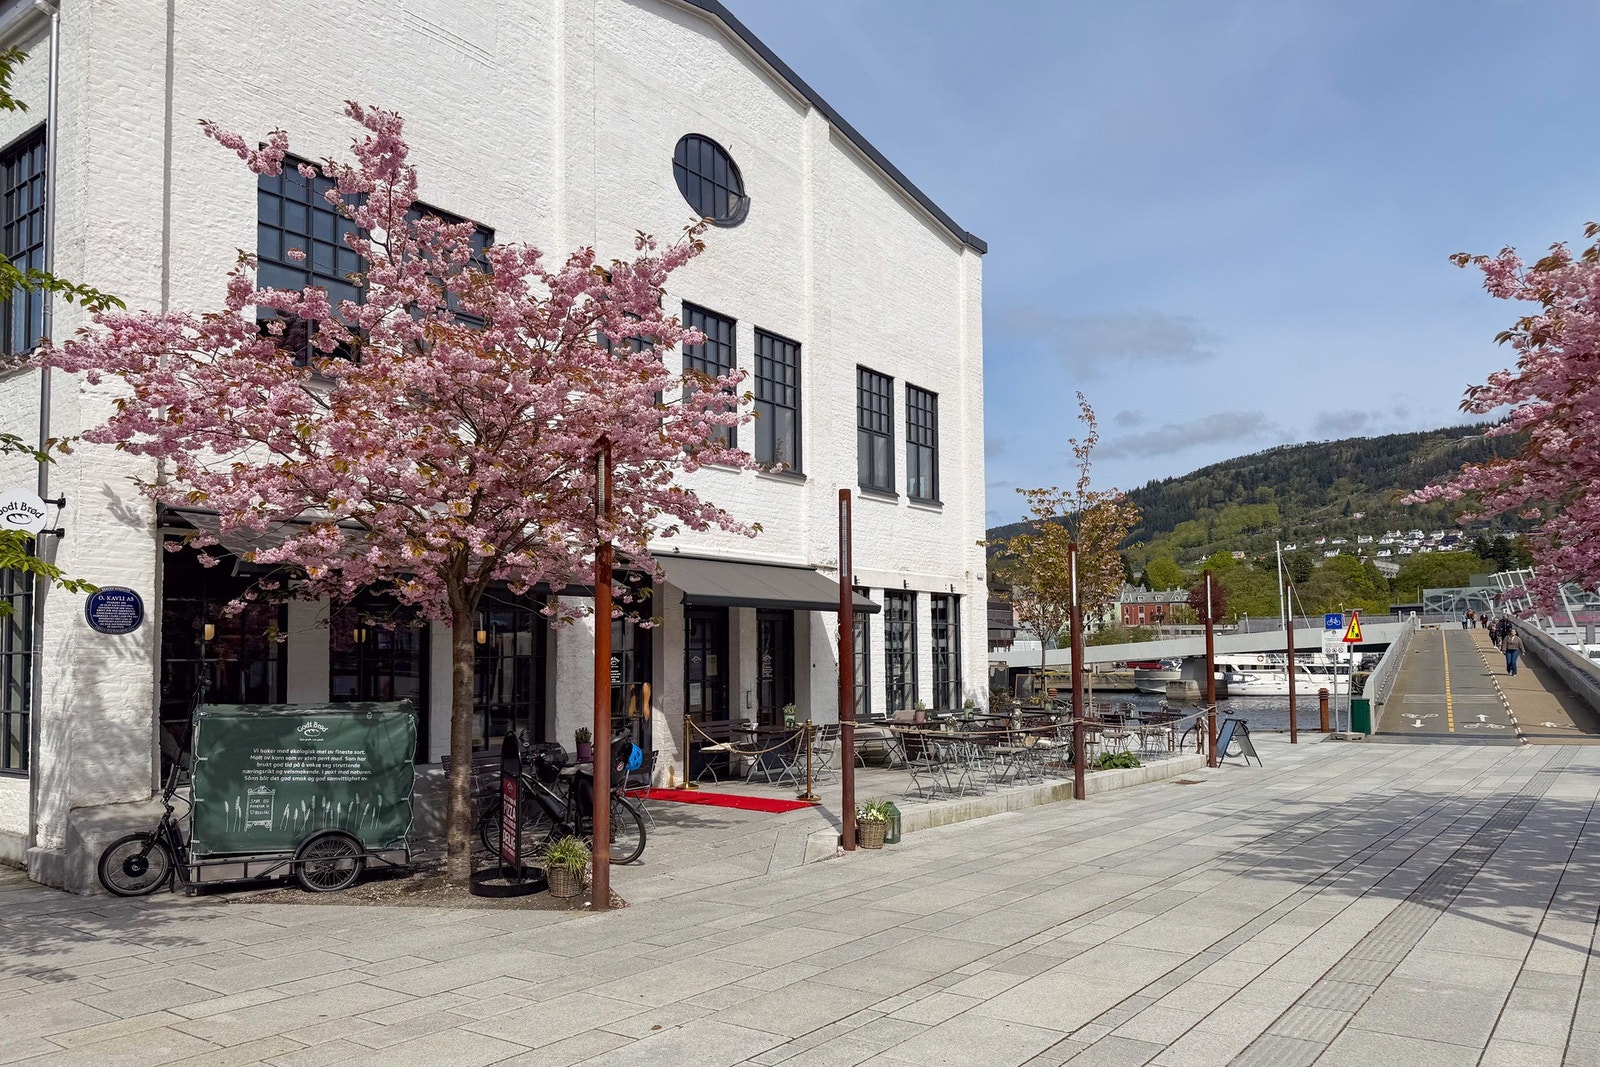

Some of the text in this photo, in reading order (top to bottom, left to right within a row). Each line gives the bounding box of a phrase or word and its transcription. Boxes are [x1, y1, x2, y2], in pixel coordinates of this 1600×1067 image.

[20, 501, 45, 519] Brød
[297, 720, 329, 733] Godt Brød
